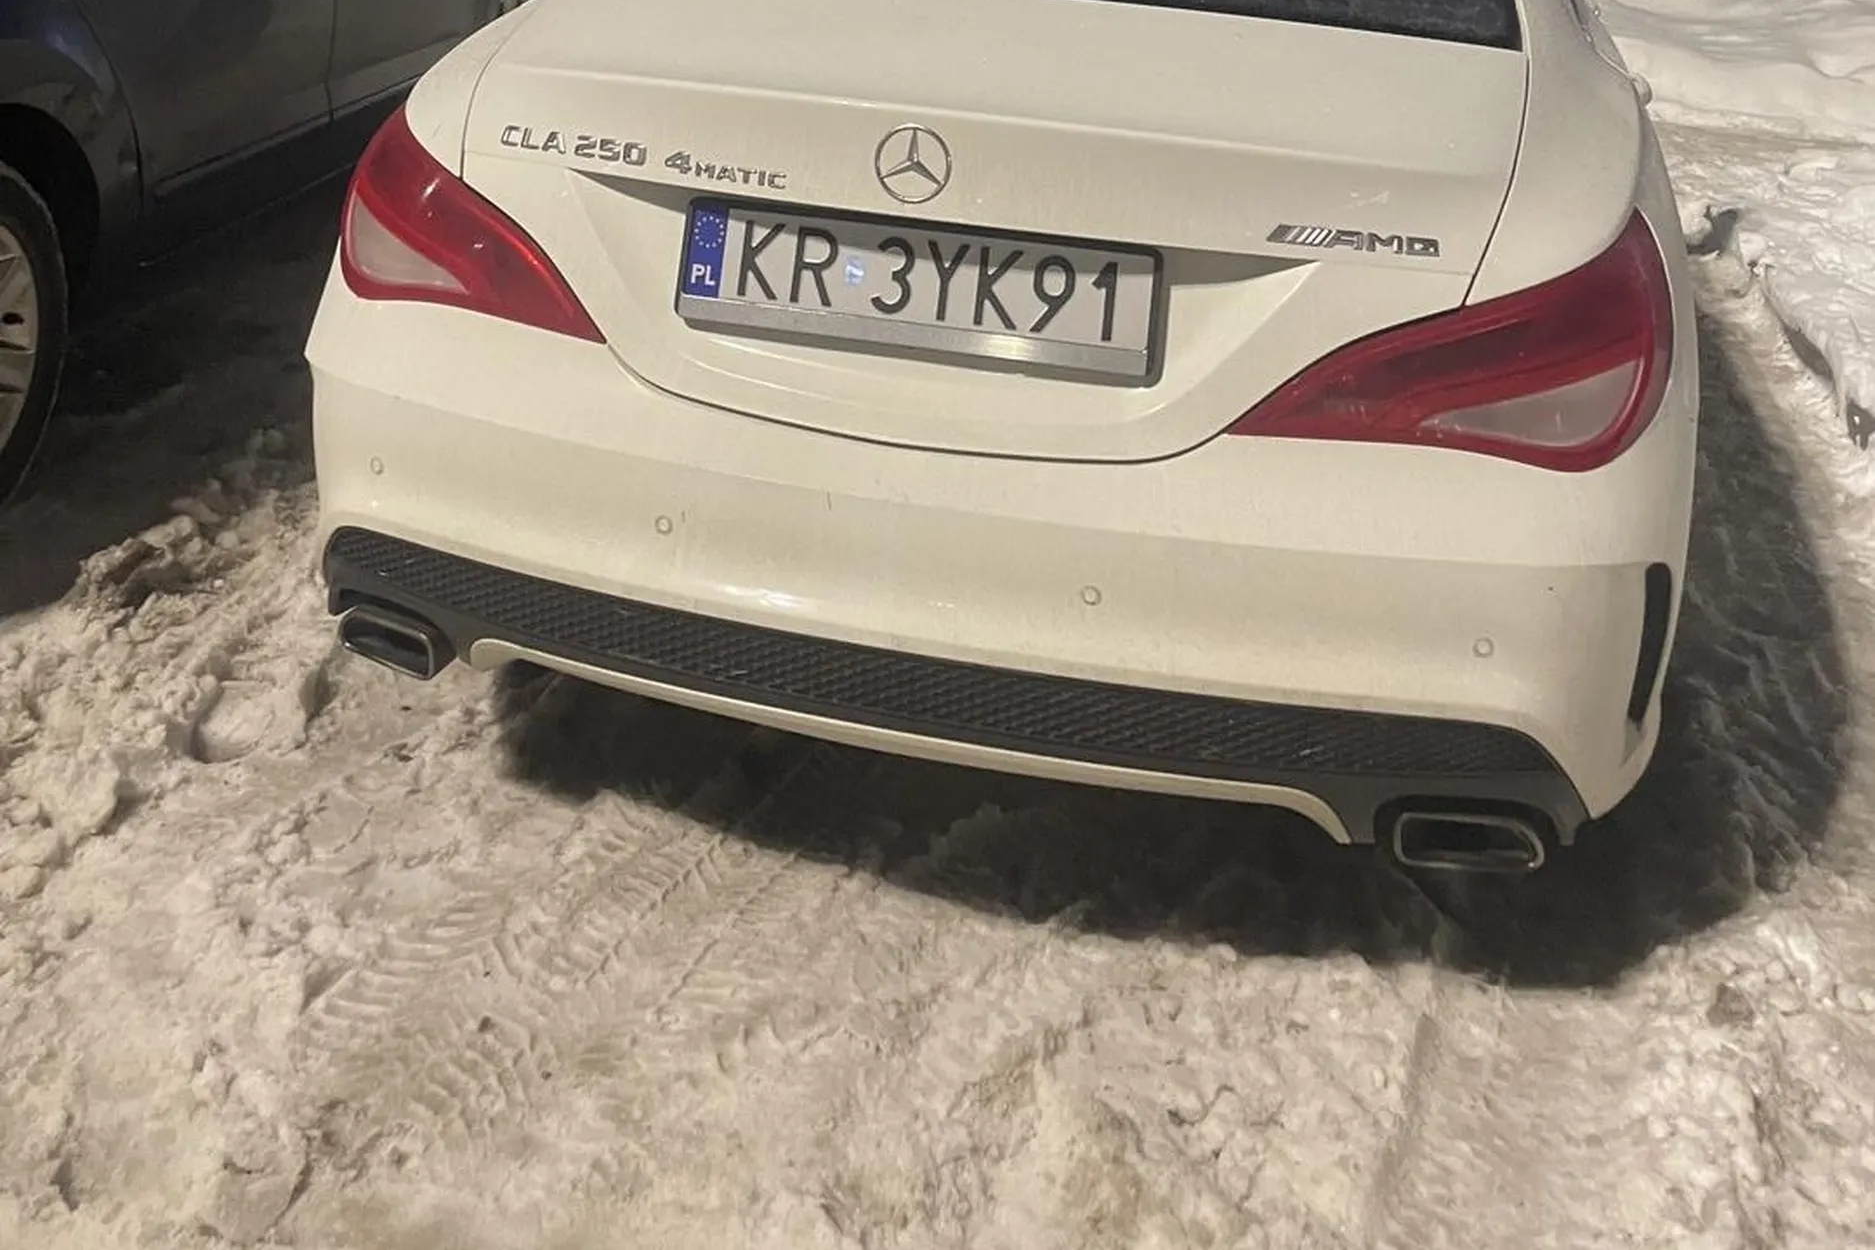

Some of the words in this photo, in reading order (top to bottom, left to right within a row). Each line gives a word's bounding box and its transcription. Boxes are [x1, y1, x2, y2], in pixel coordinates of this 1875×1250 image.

[500, 124, 567, 155] CLA
[574, 134, 648, 167] 250
[664, 151, 788, 190] 4MATIC
[1323, 228, 1441, 258] AMG
[690, 262, 717, 287] PL
[736, 218, 839, 308] KR
[870, 236, 1120, 342] 3YK91
